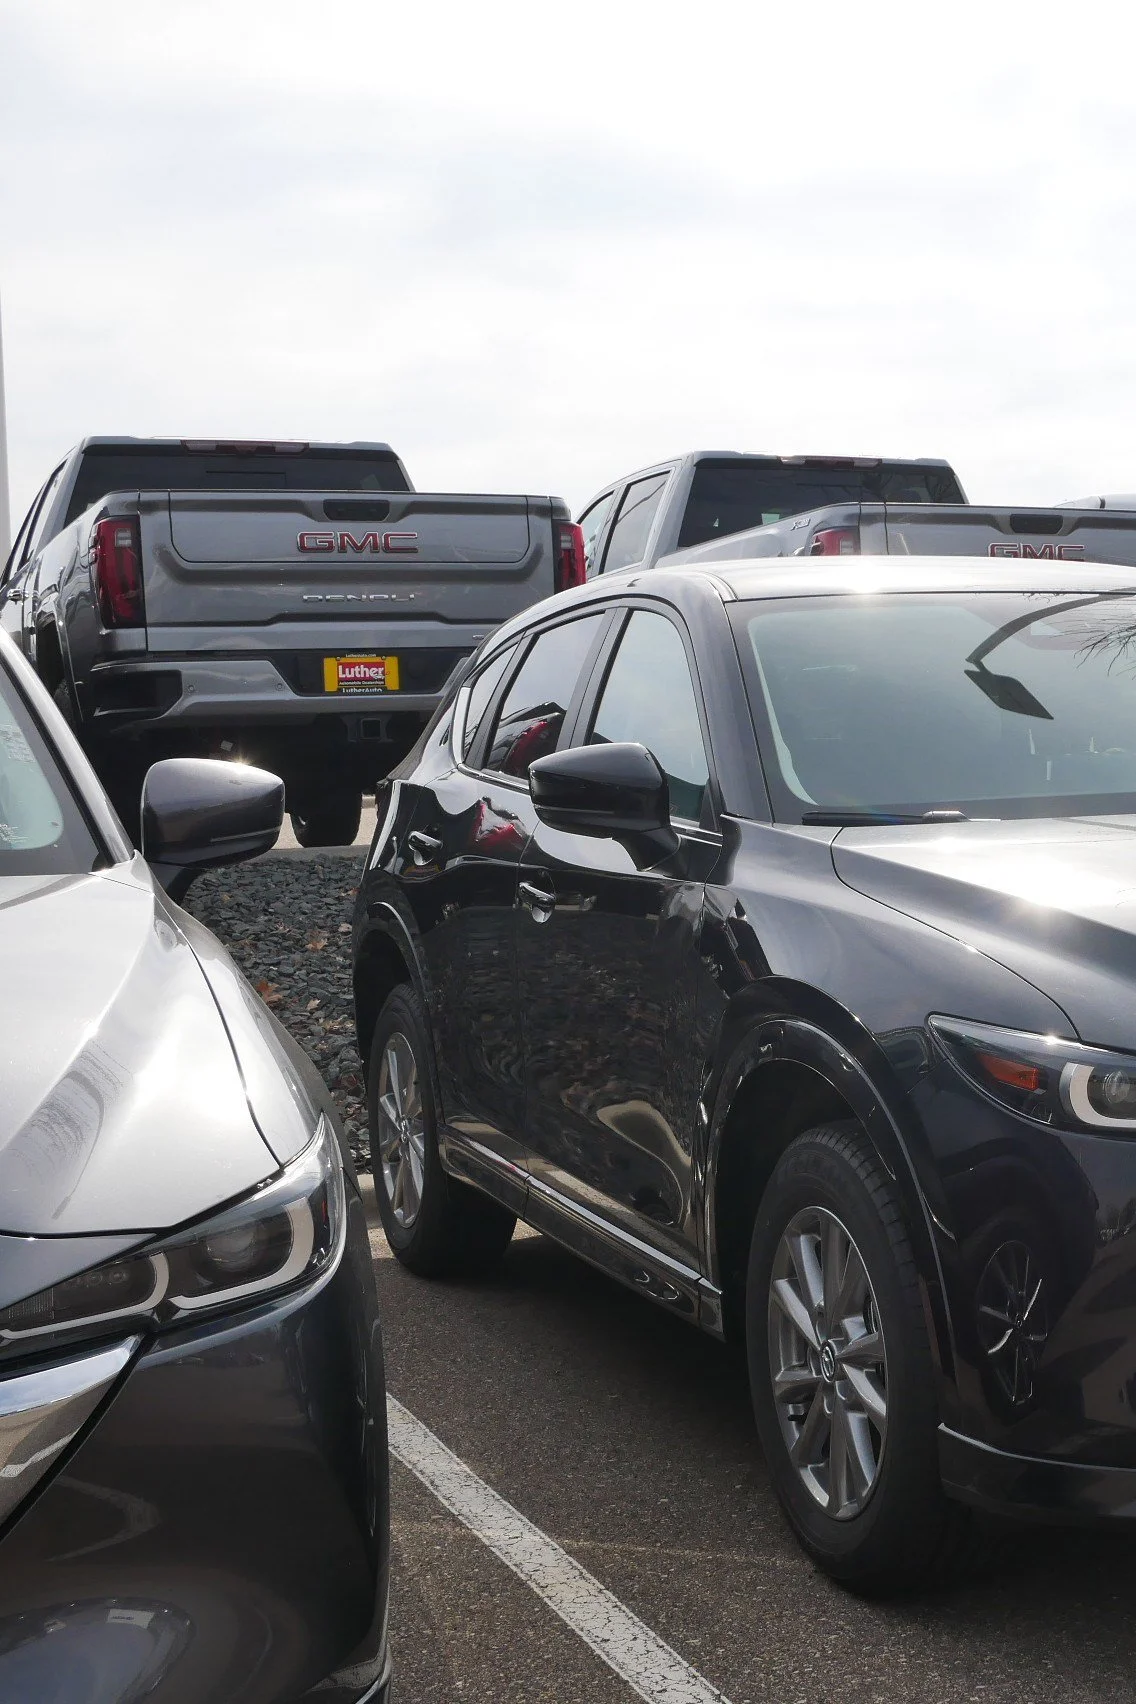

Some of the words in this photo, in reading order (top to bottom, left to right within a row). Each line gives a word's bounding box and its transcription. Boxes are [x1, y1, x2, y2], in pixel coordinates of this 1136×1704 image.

[297, 531, 418, 553] GMC
[988, 542, 1085, 562] GMC
[338, 664, 385, 678] Luther
